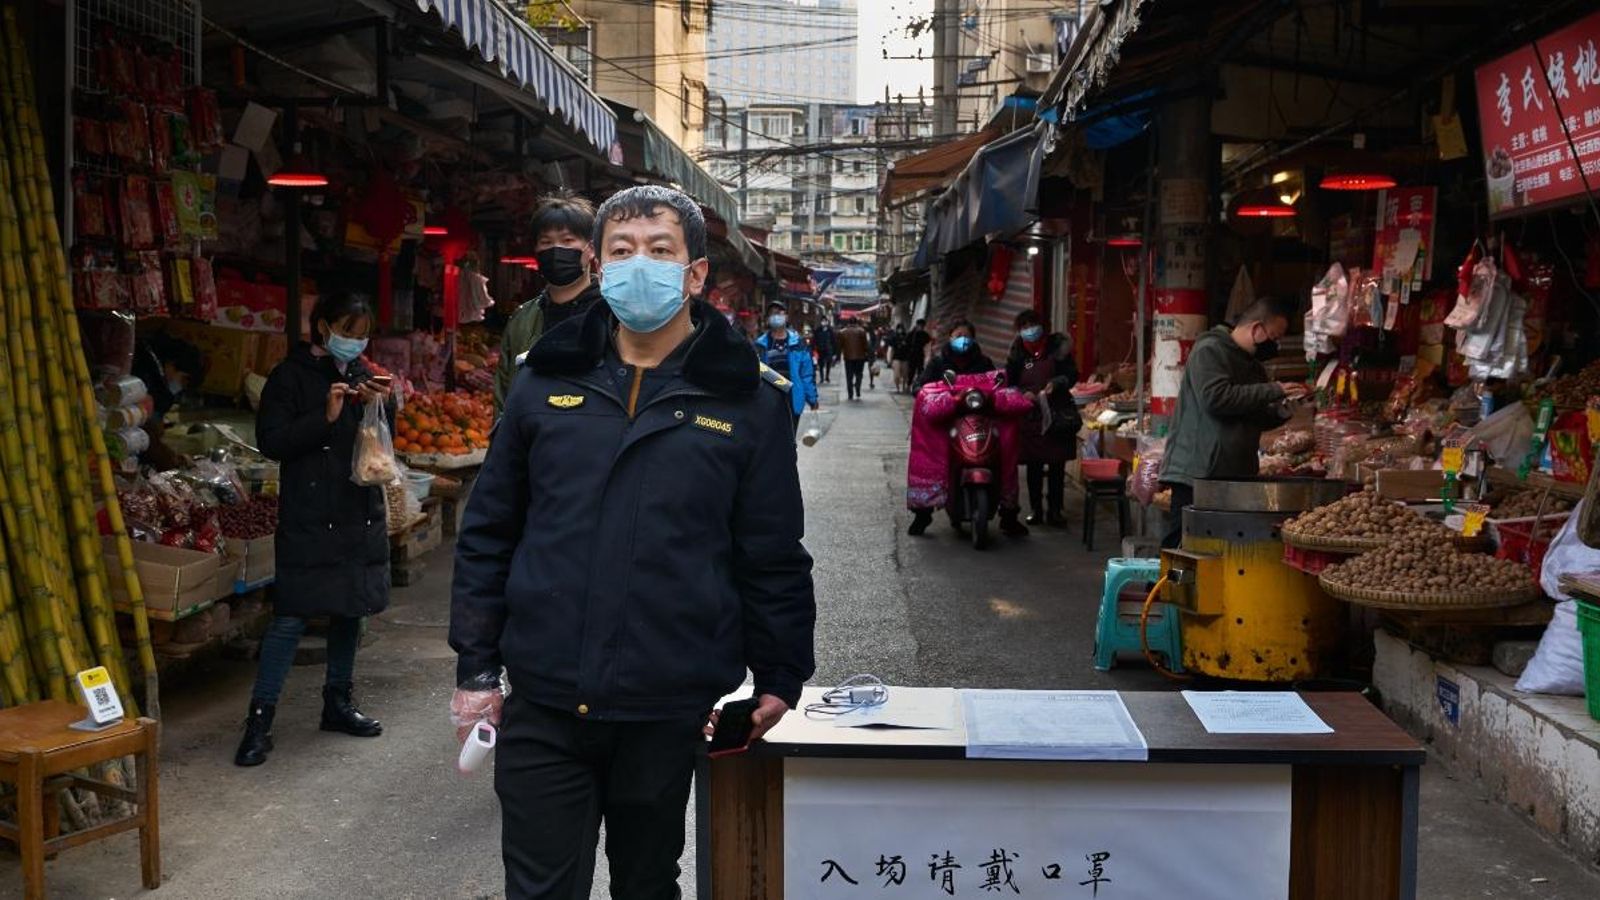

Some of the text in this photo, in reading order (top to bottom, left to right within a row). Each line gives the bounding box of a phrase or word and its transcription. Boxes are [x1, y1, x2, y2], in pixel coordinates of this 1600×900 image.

[820, 848, 1112, 898] 入场请戴口罩
